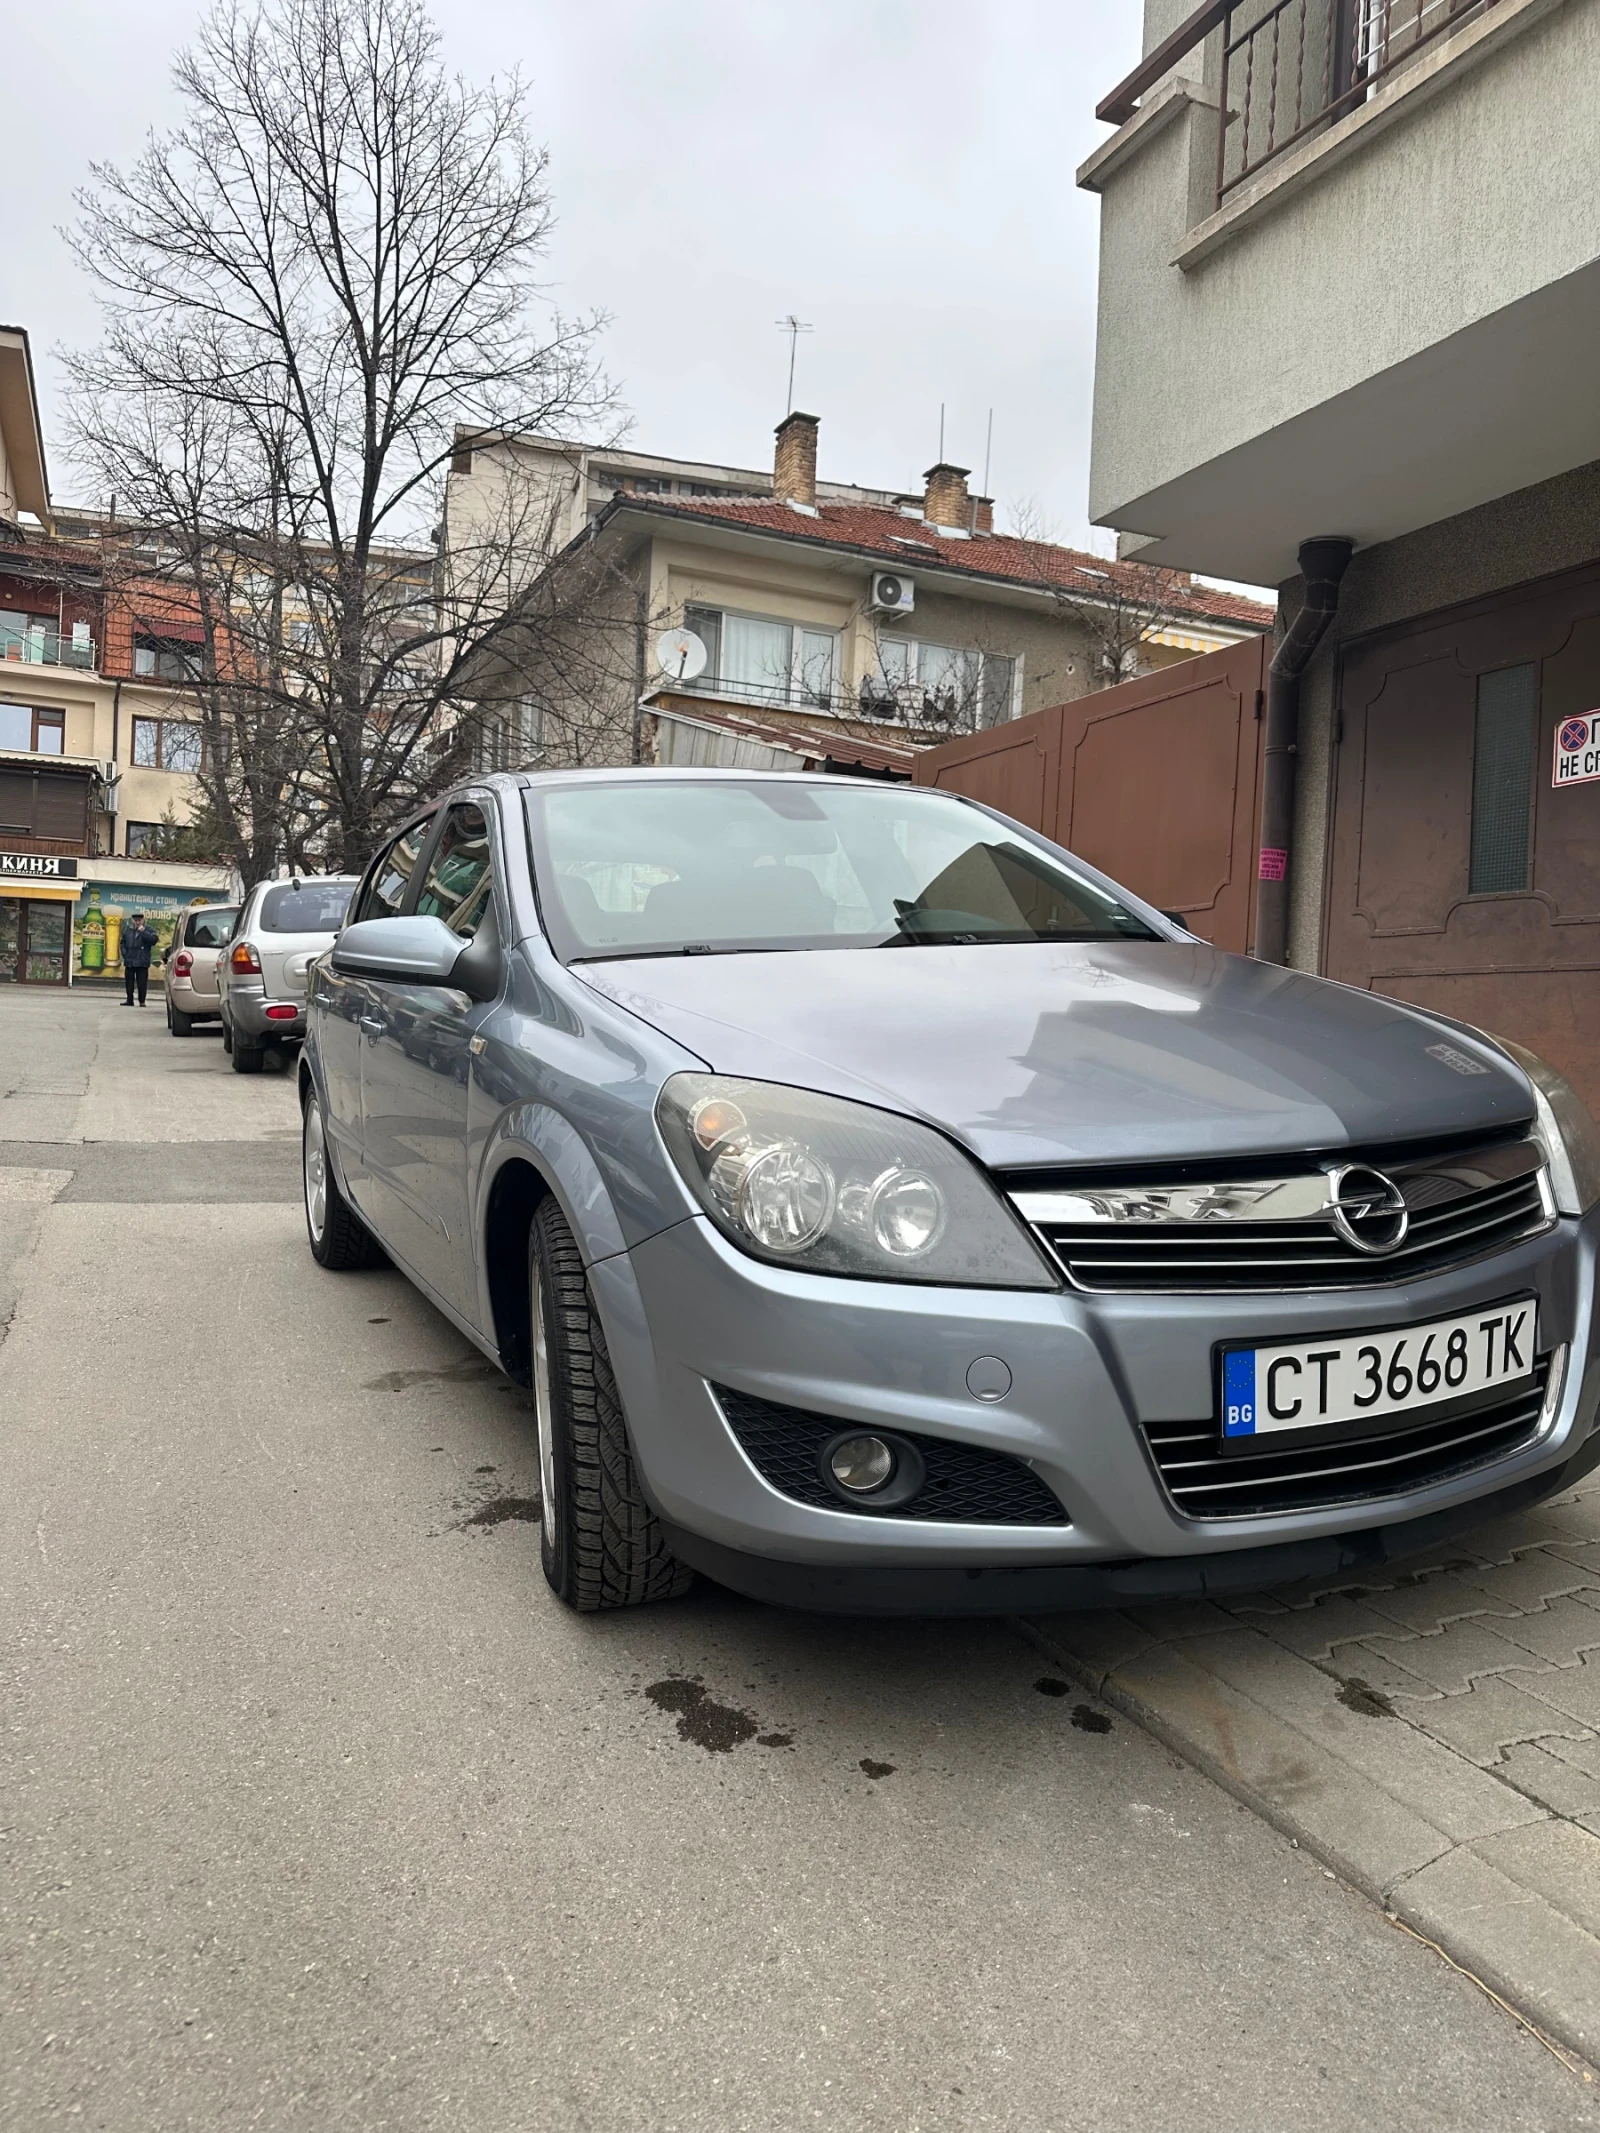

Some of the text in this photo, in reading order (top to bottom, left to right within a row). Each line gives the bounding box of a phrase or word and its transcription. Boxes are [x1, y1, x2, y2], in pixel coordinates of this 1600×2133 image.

[1560, 755, 1579, 778] НЕ
[2, 856, 60, 874] КИНЯ
[1266, 1310, 1527, 1420] CT 3668 TK
[1228, 1404, 1252, 1425] BG
